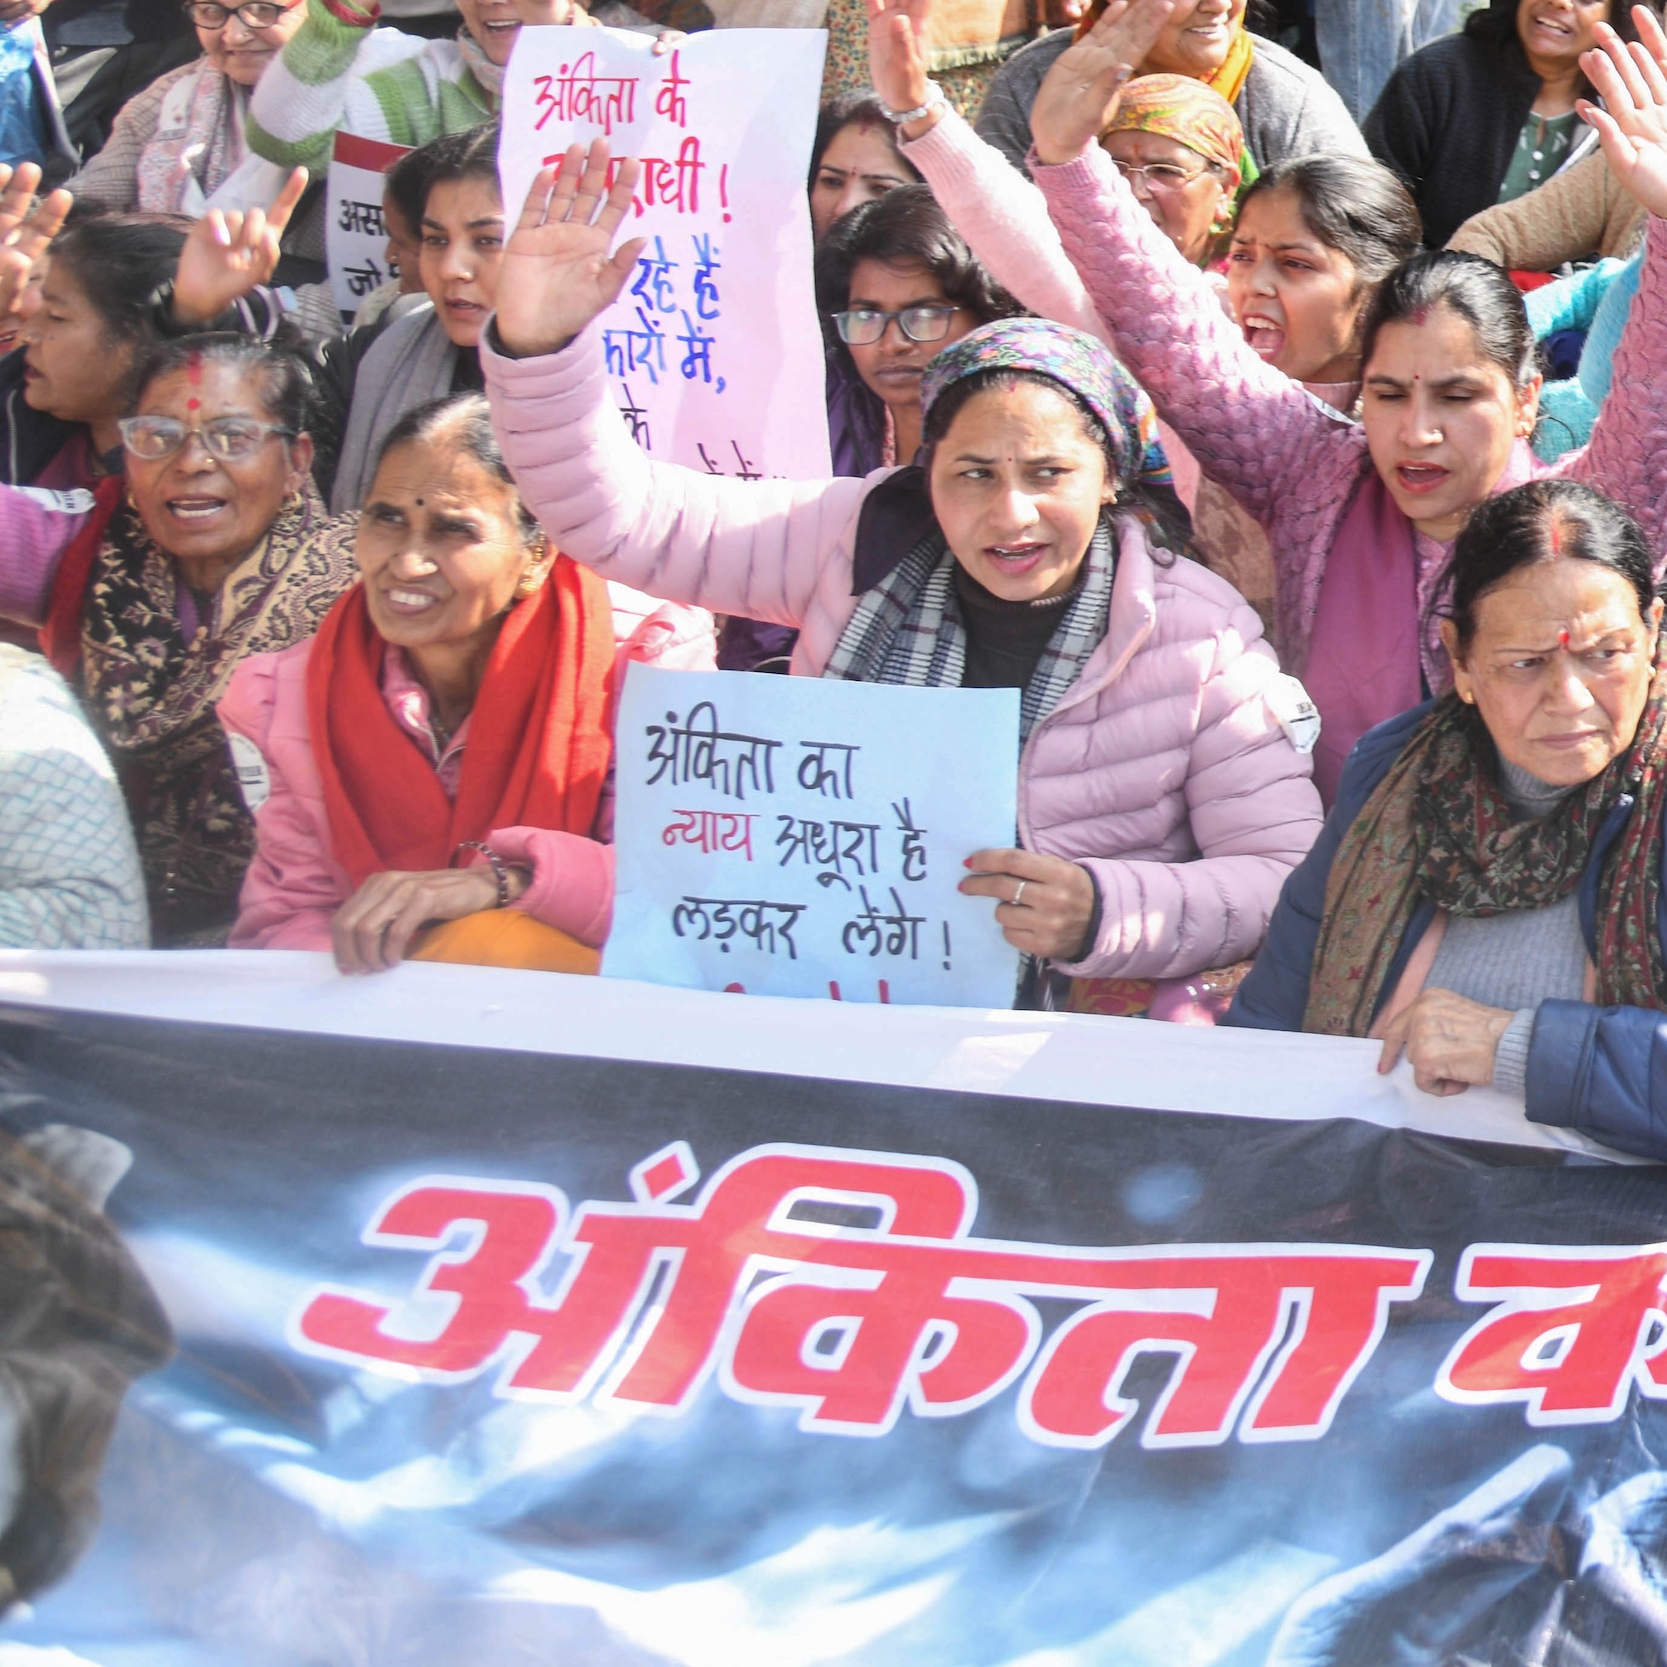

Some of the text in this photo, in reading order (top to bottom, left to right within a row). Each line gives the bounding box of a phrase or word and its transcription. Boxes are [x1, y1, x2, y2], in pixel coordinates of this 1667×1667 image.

[534, 49, 691, 136] अंकिता के
[630, 232, 721, 320] रहे हैं
[646, 700, 861, 800] अंकिता का
[662, 796, 928, 892] न्याय अधूरा है
[672, 894, 808, 960] लड़कर
[291, 1142, 1433, 1446] अंकिता
